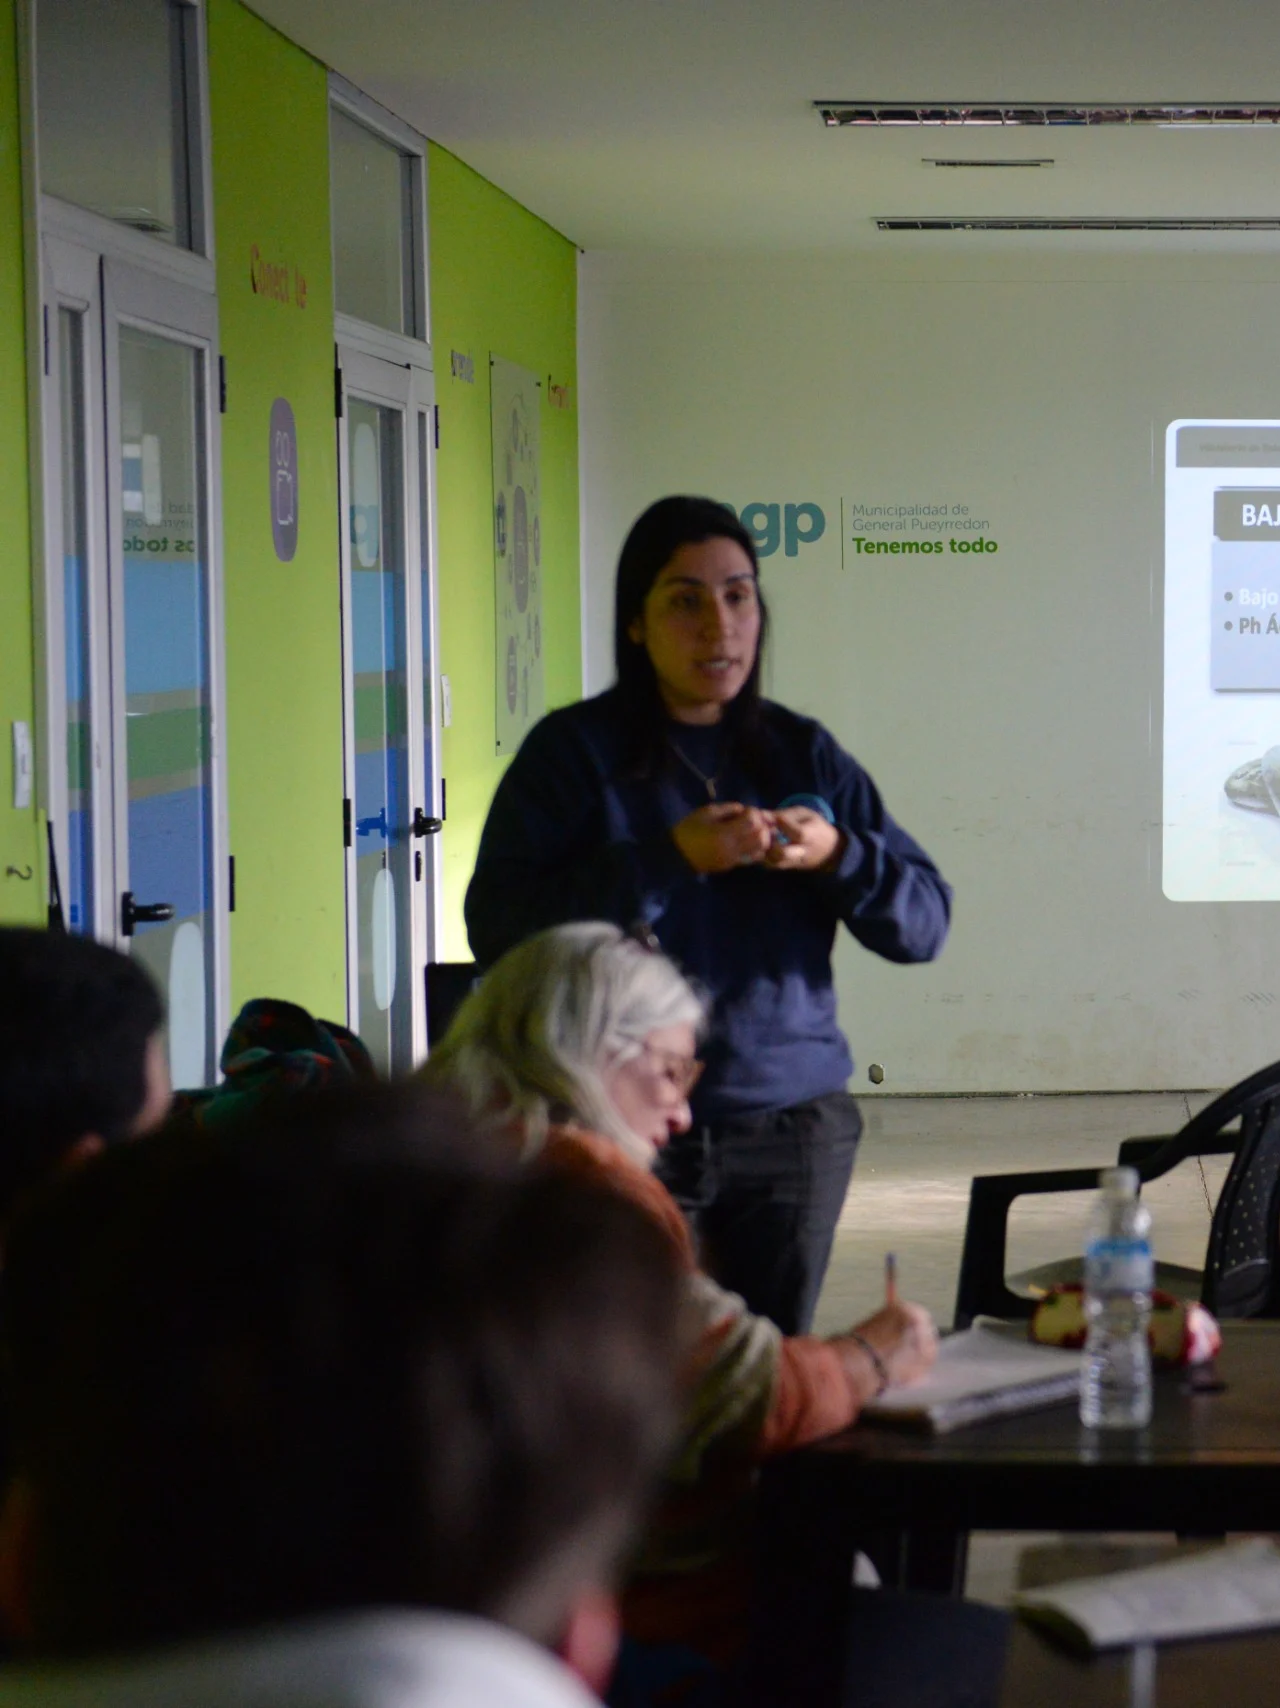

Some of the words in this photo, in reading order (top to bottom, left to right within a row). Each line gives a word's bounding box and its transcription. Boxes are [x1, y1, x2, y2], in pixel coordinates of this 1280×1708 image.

[852, 503, 949, 518] Municipalidad
[952, 503, 969, 516] de
[722, 502, 826, 557] gp
[852, 517, 907, 531] General
[911, 518, 991, 533] Pueyrredon
[852, 537, 944, 554] Tenemos
[949, 536, 998, 554] todo
[1239, 588, 1279, 609] Bajo
[1239, 616, 1261, 635] Ph
